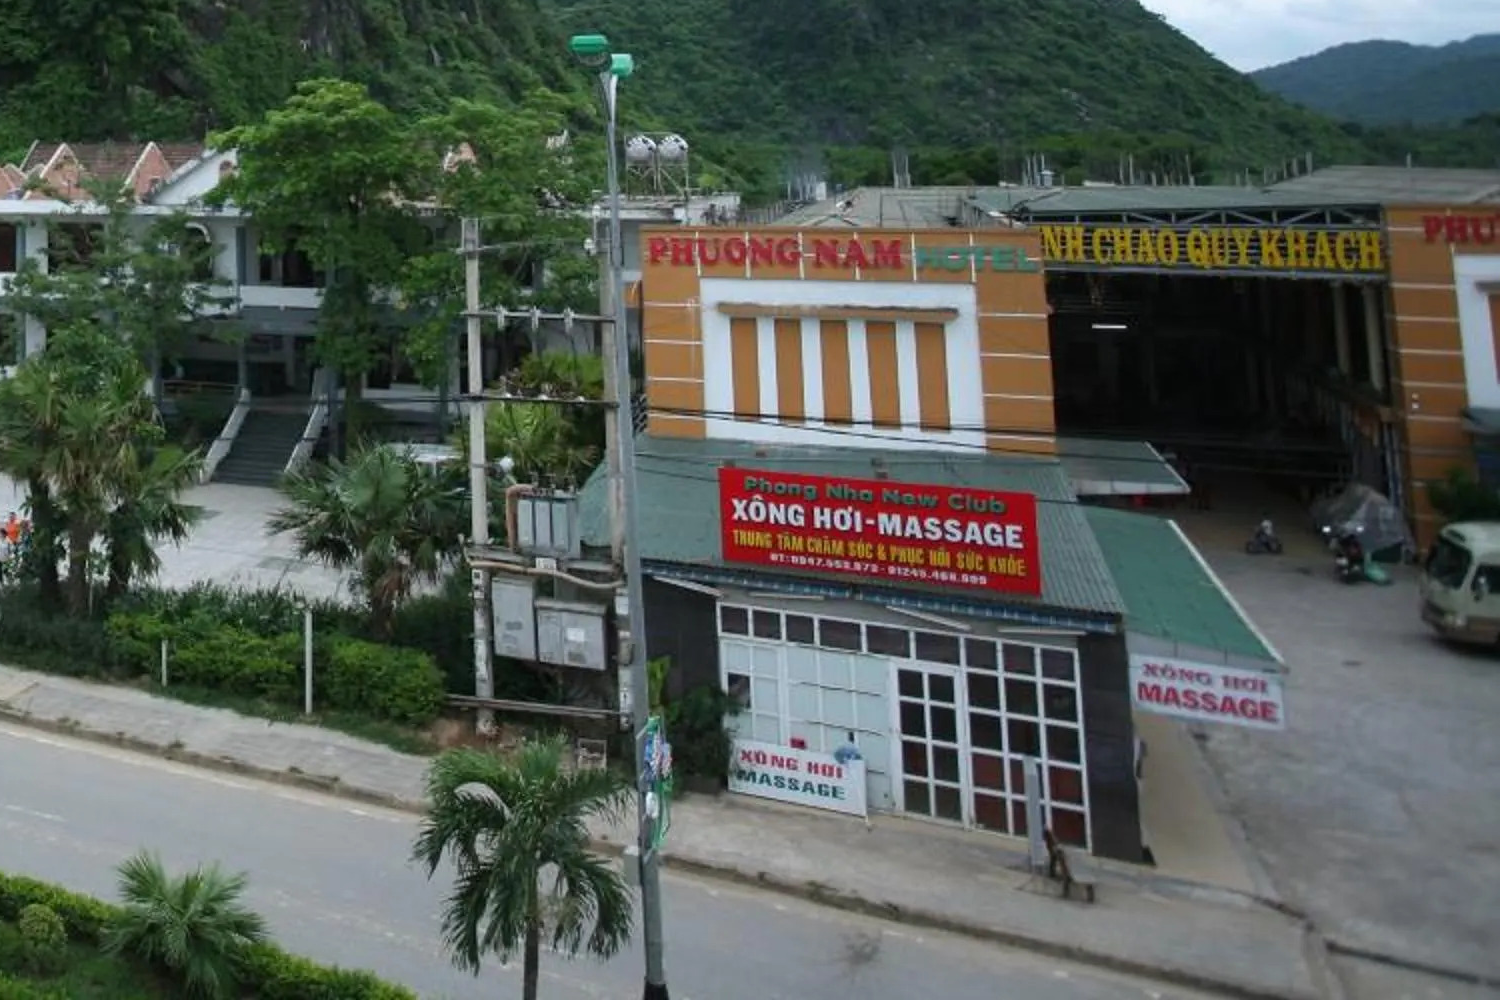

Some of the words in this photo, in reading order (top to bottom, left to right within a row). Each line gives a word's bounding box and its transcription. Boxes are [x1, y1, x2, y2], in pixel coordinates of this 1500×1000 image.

[812, 238, 904, 270] NAM
[915, 245, 1038, 273] HOTEL
[731, 494, 805, 527] XÔNG
[744, 475, 818, 500] Phong
[826, 482, 874, 503] Nha
[882, 487, 939, 509] New
[947, 492, 1007, 514] Club
[732, 528, 773, 549] TRUNG
[1137, 681, 1280, 723] MASSAGE
[736, 769, 846, 801] MASSAGE
